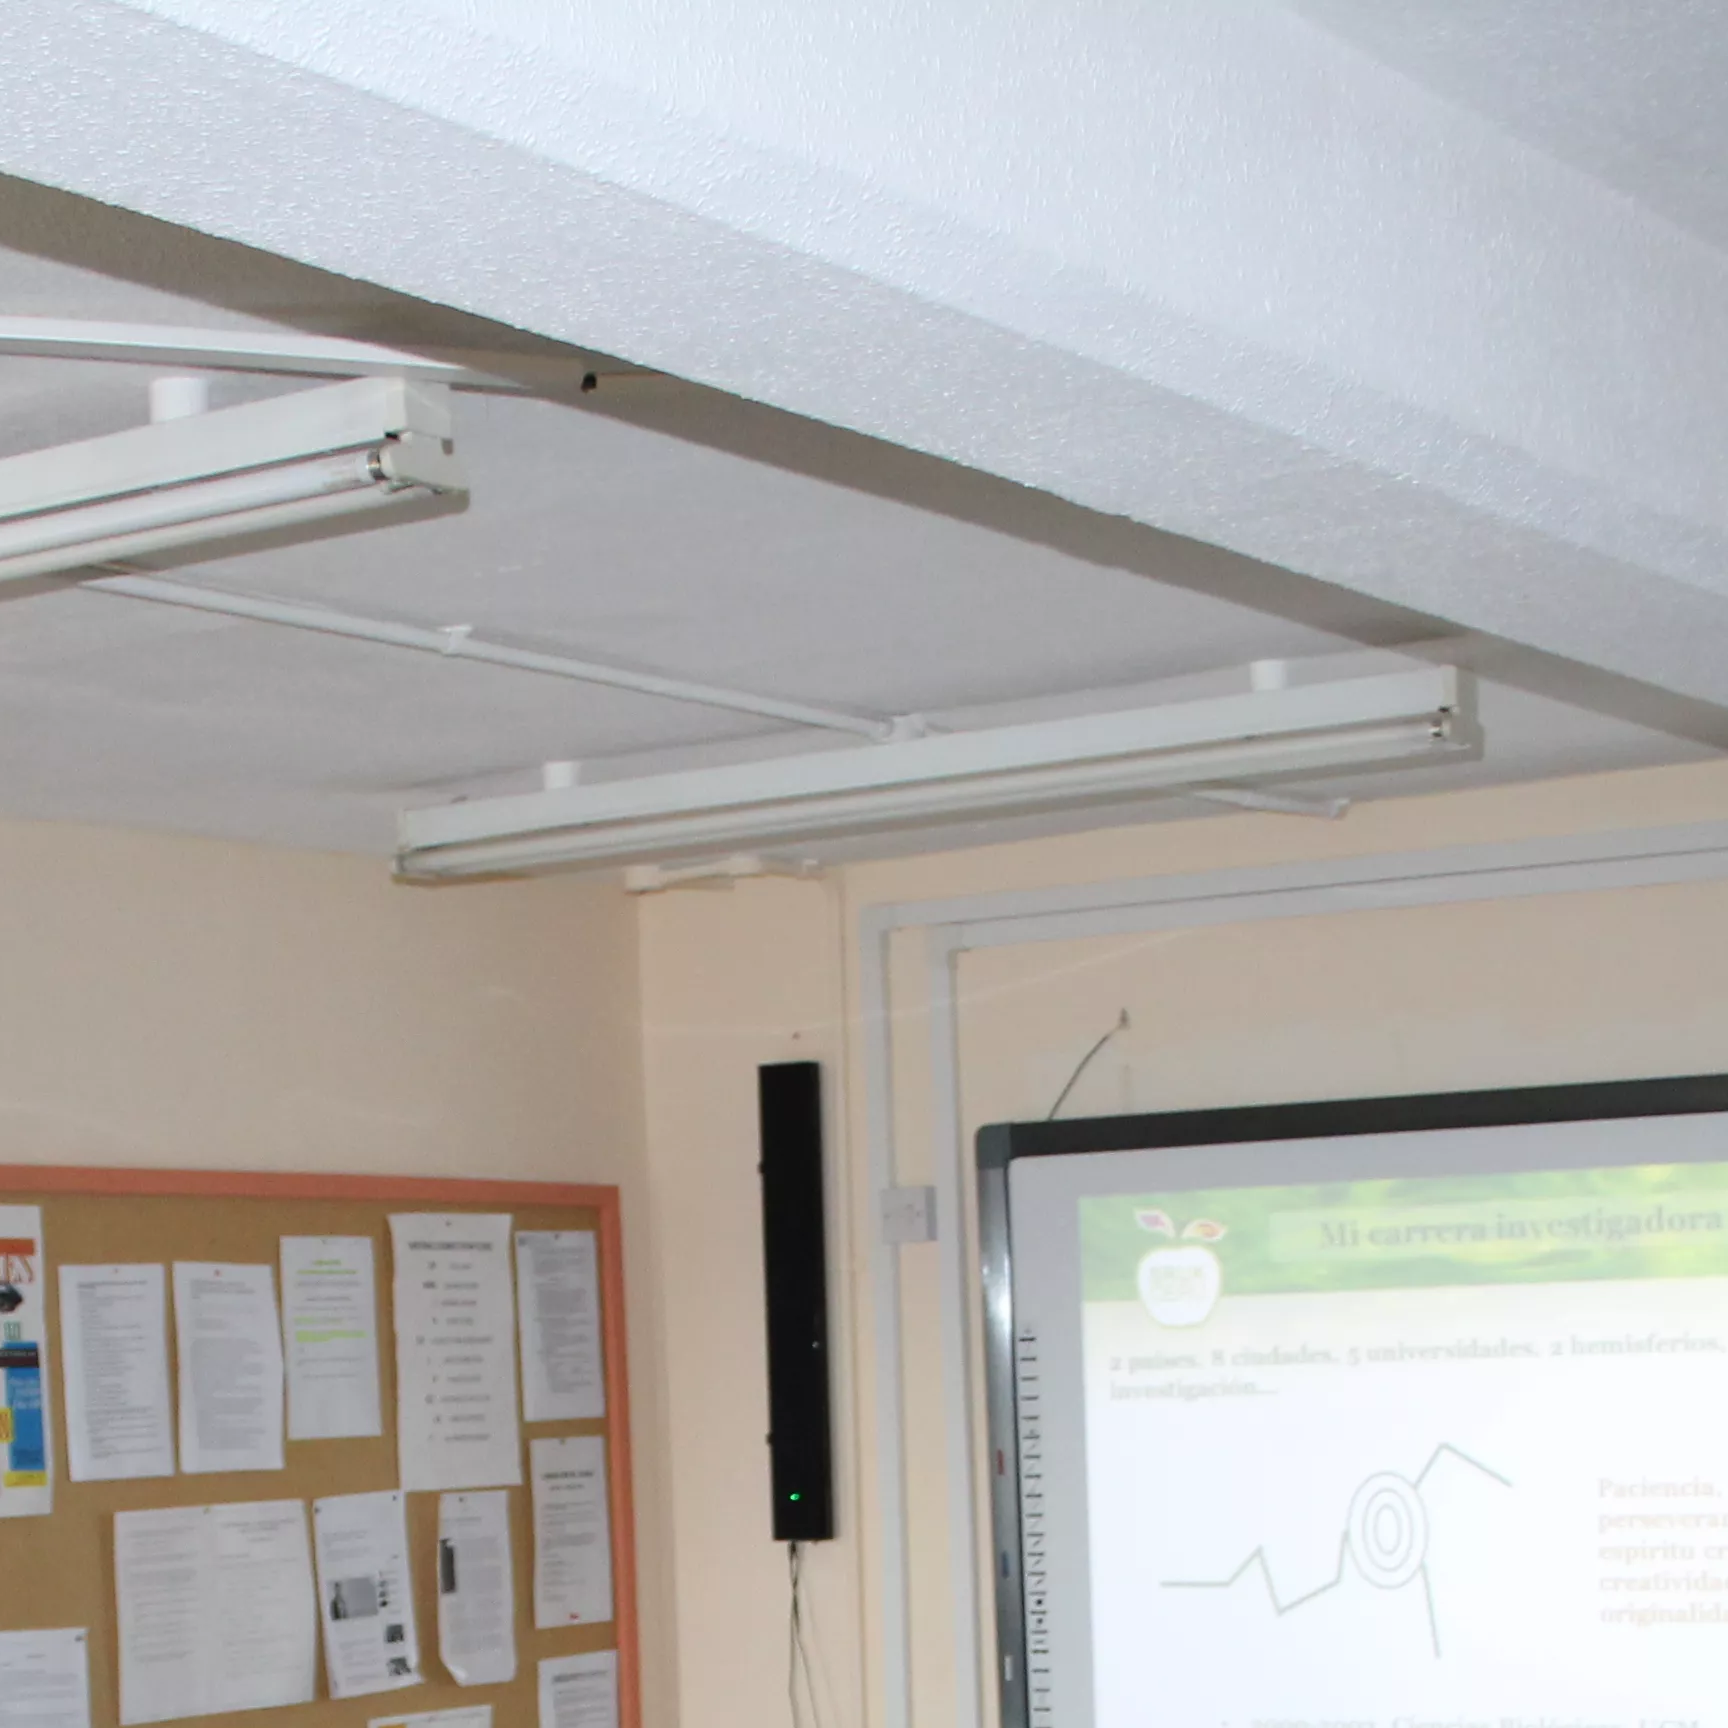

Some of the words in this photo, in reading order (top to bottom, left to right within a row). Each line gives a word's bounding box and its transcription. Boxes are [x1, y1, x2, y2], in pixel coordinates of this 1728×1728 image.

[1320, 1219, 1359, 1249] Mi
[1369, 1222, 1486, 1248] carrera
[1496, 1206, 1725, 1240] investigadora
